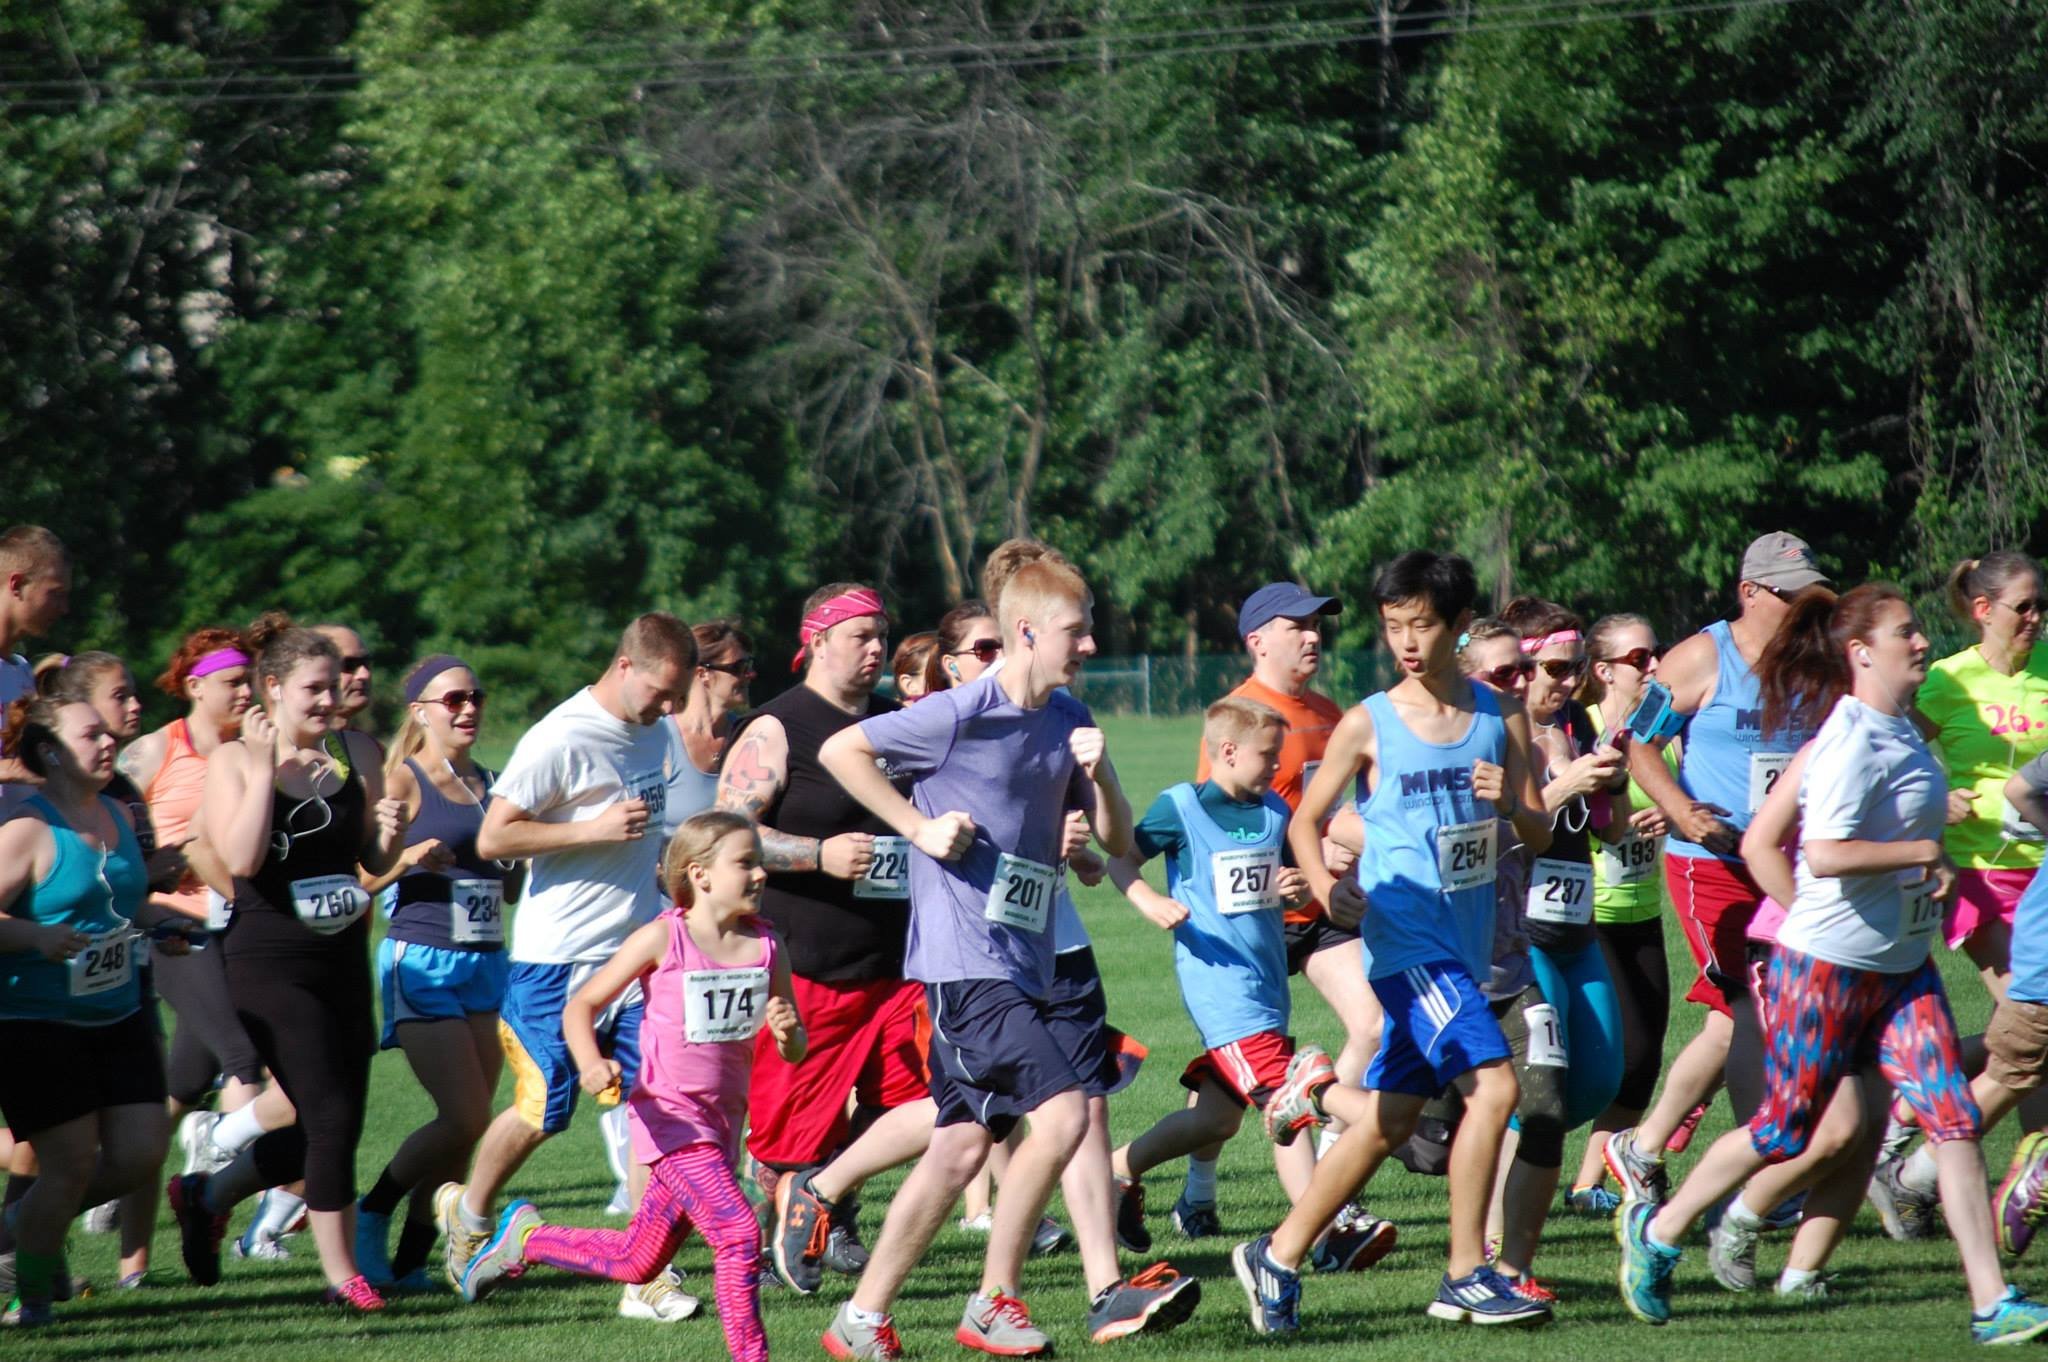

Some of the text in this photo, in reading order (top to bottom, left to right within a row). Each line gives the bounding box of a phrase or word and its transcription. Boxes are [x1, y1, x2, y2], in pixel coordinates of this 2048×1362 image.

[1984, 698, 2048, 737] 26.
[870, 852, 909, 880] 224
[1452, 838, 1488, 872] 254
[1617, 838, 1656, 868] 193
[1005, 873, 1044, 911] 201
[1229, 864, 1272, 894] 257
[1544, 875, 1586, 905] 237
[310, 889, 357, 920] 260
[85, 942, 125, 977] 248
[703, 988, 754, 1020] 174
